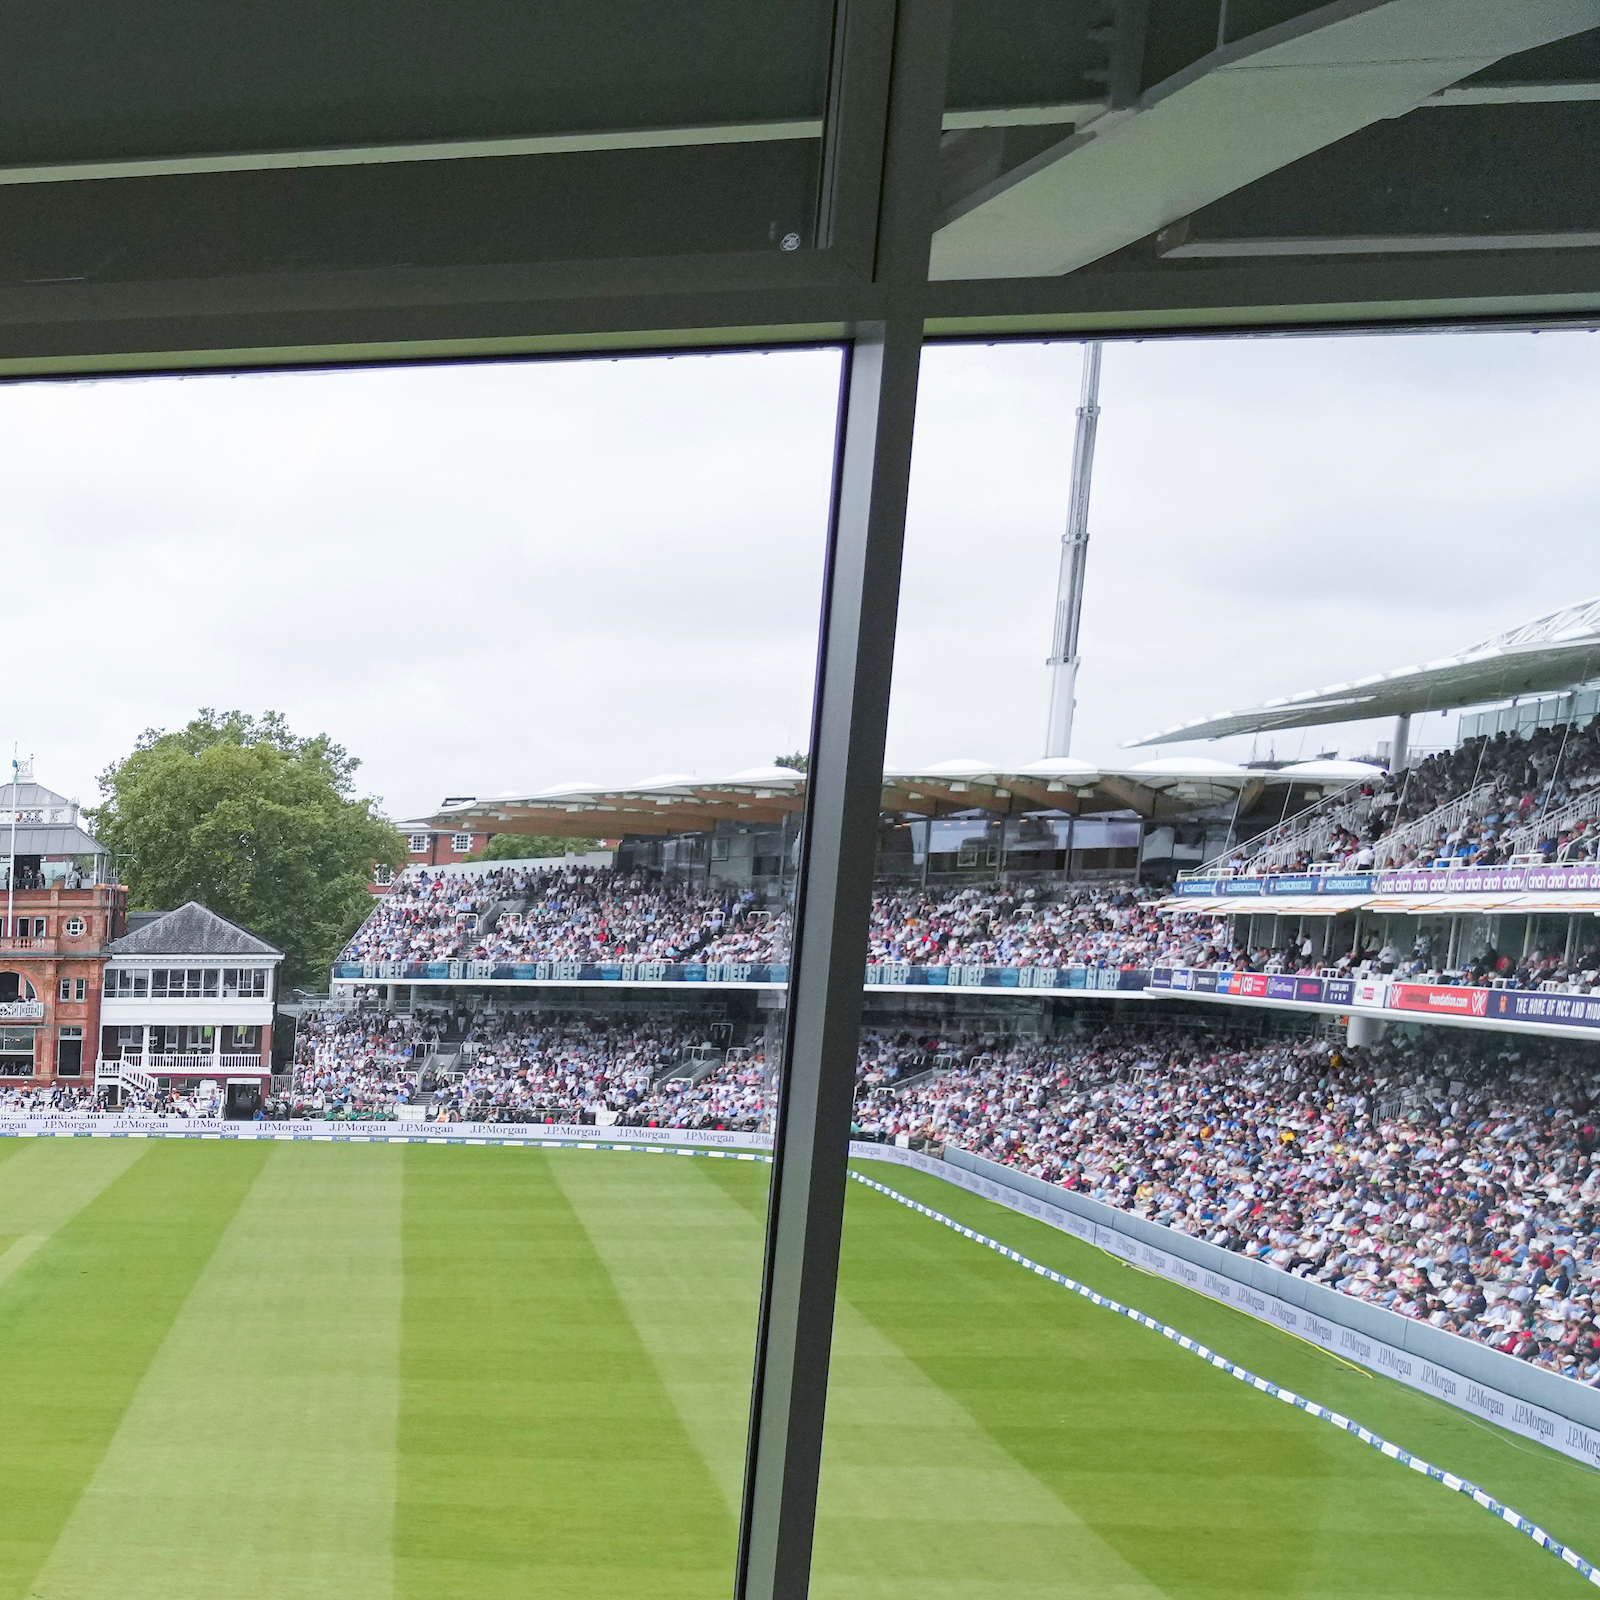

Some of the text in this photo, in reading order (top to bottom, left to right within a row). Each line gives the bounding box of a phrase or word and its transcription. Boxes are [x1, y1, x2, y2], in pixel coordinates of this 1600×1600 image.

[379, 963, 408, 979] DEEP
[638, 964, 666, 981] DEEP
[1033, 968, 1057, 988] DEEP
[1429, 992, 1468, 1008] foundation.com
[1516, 997, 1527, 1014] THE
[1528, 998, 1548, 1016] HOME
[1548, 1000, 1555, 1016] OF
[1556, 1001, 1570, 1017] MCC
[1570, 1001, 1584, 1018] AND
[256, 1122, 313, 1132] J.P.Morgan
[398, 1123, 454, 1135] J.P.Morgan
[544, 1126, 601, 1138] J.P.Morgan
[1378, 1347, 1412, 1378] J.P.Morgan
[1420, 1364, 1456, 1398] J.P.Morgan
[1466, 1384, 1504, 1419] J.P.Morgan
[1512, 1404, 1554, 1439] J.P.Morgan
